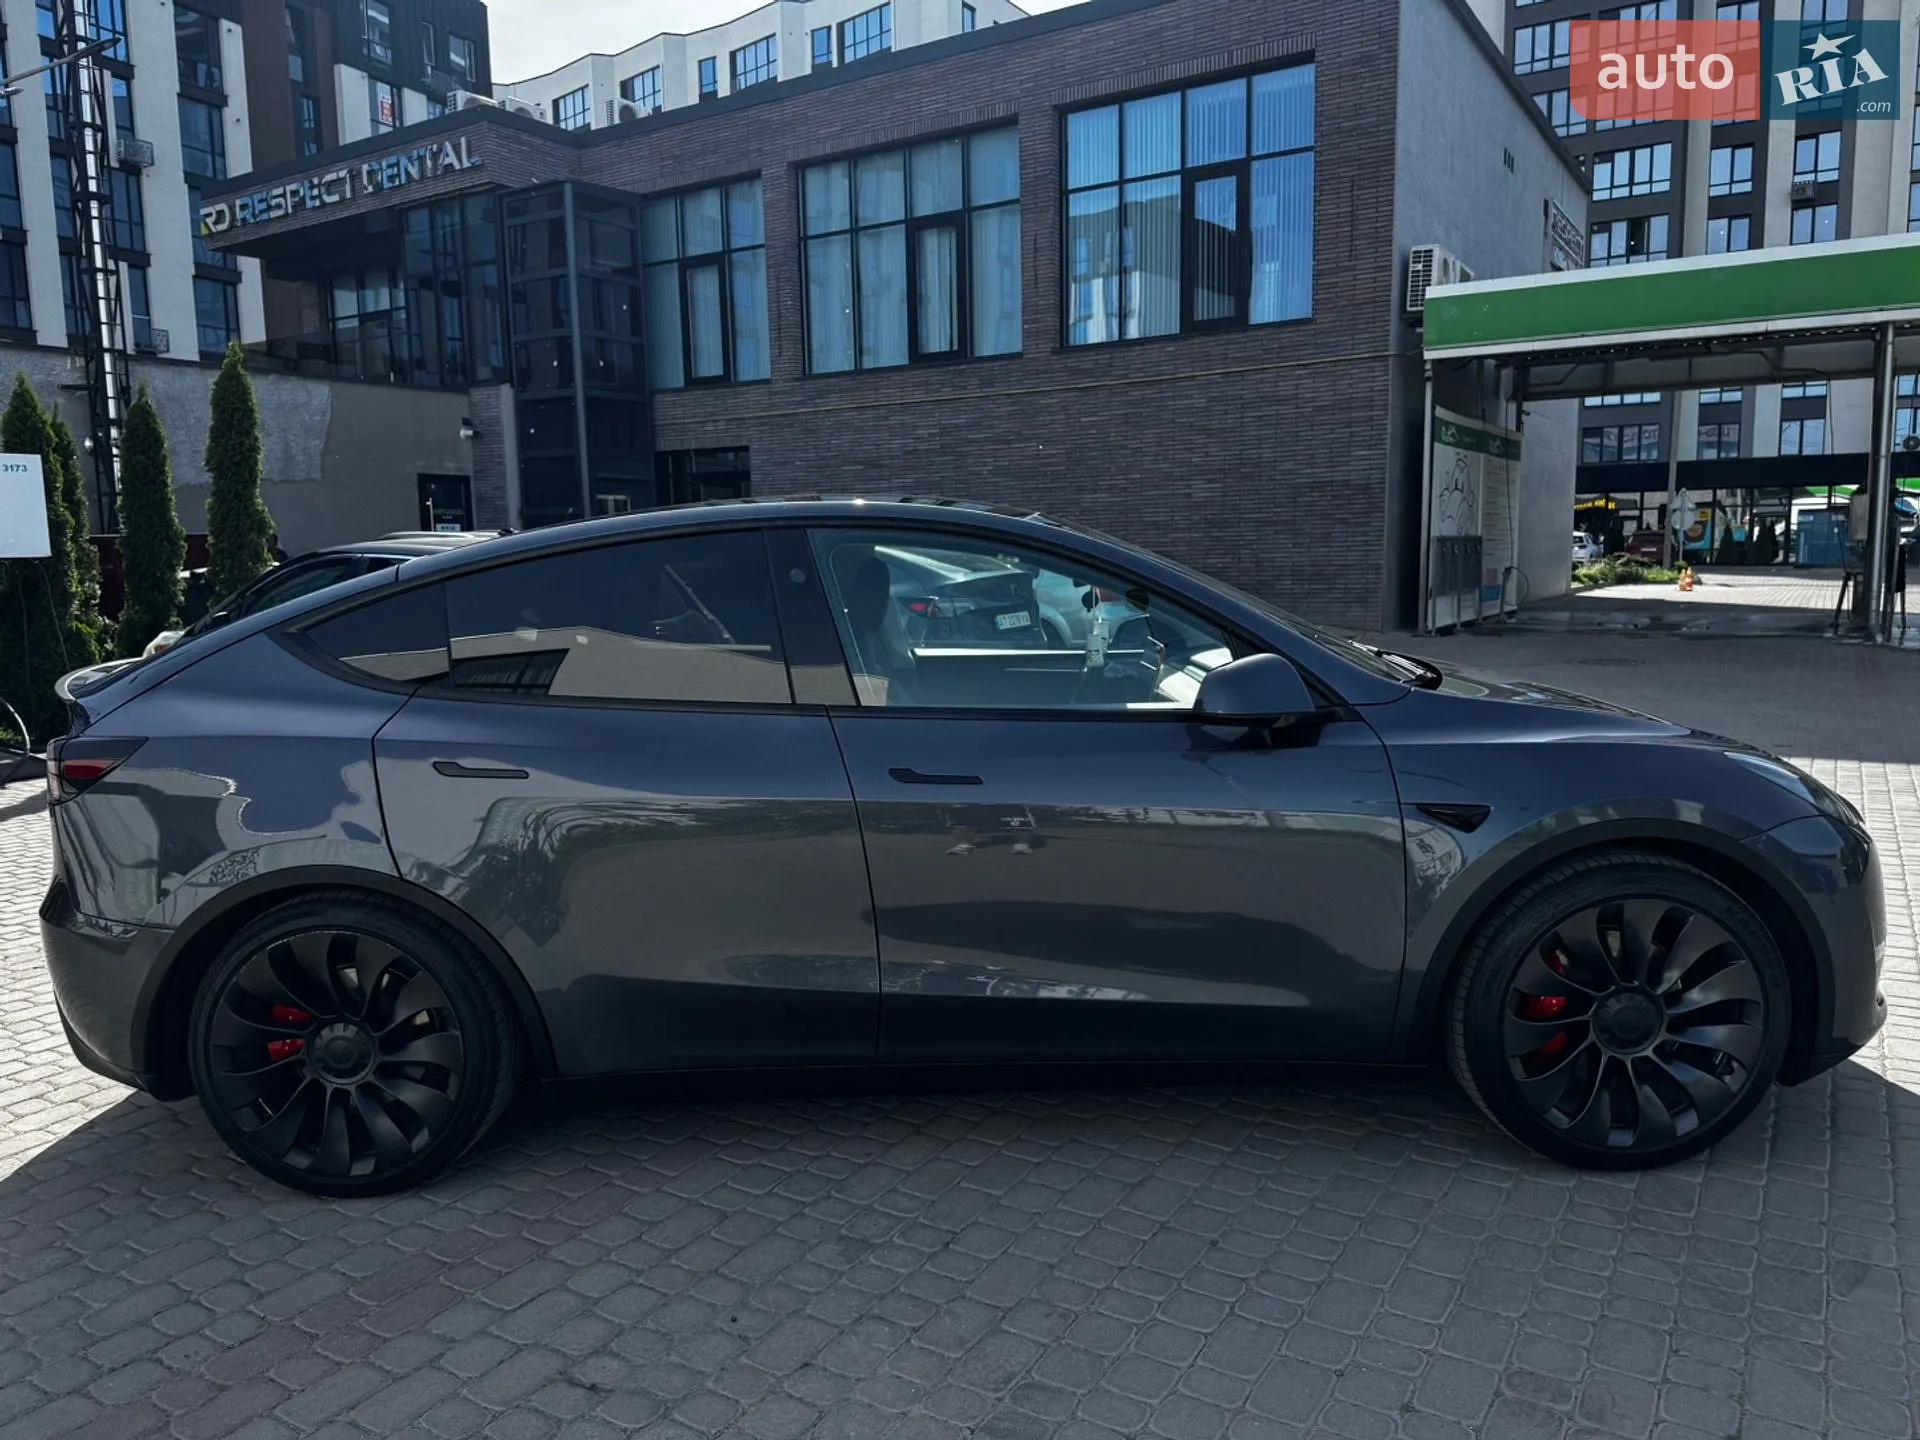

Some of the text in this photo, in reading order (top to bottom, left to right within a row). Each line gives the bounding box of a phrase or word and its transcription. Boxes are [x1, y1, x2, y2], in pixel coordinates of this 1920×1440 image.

[234, 168, 355, 226] RESPECT
[361, 136, 482, 194] DENTAL
[2, 464, 28, 473] 3173
